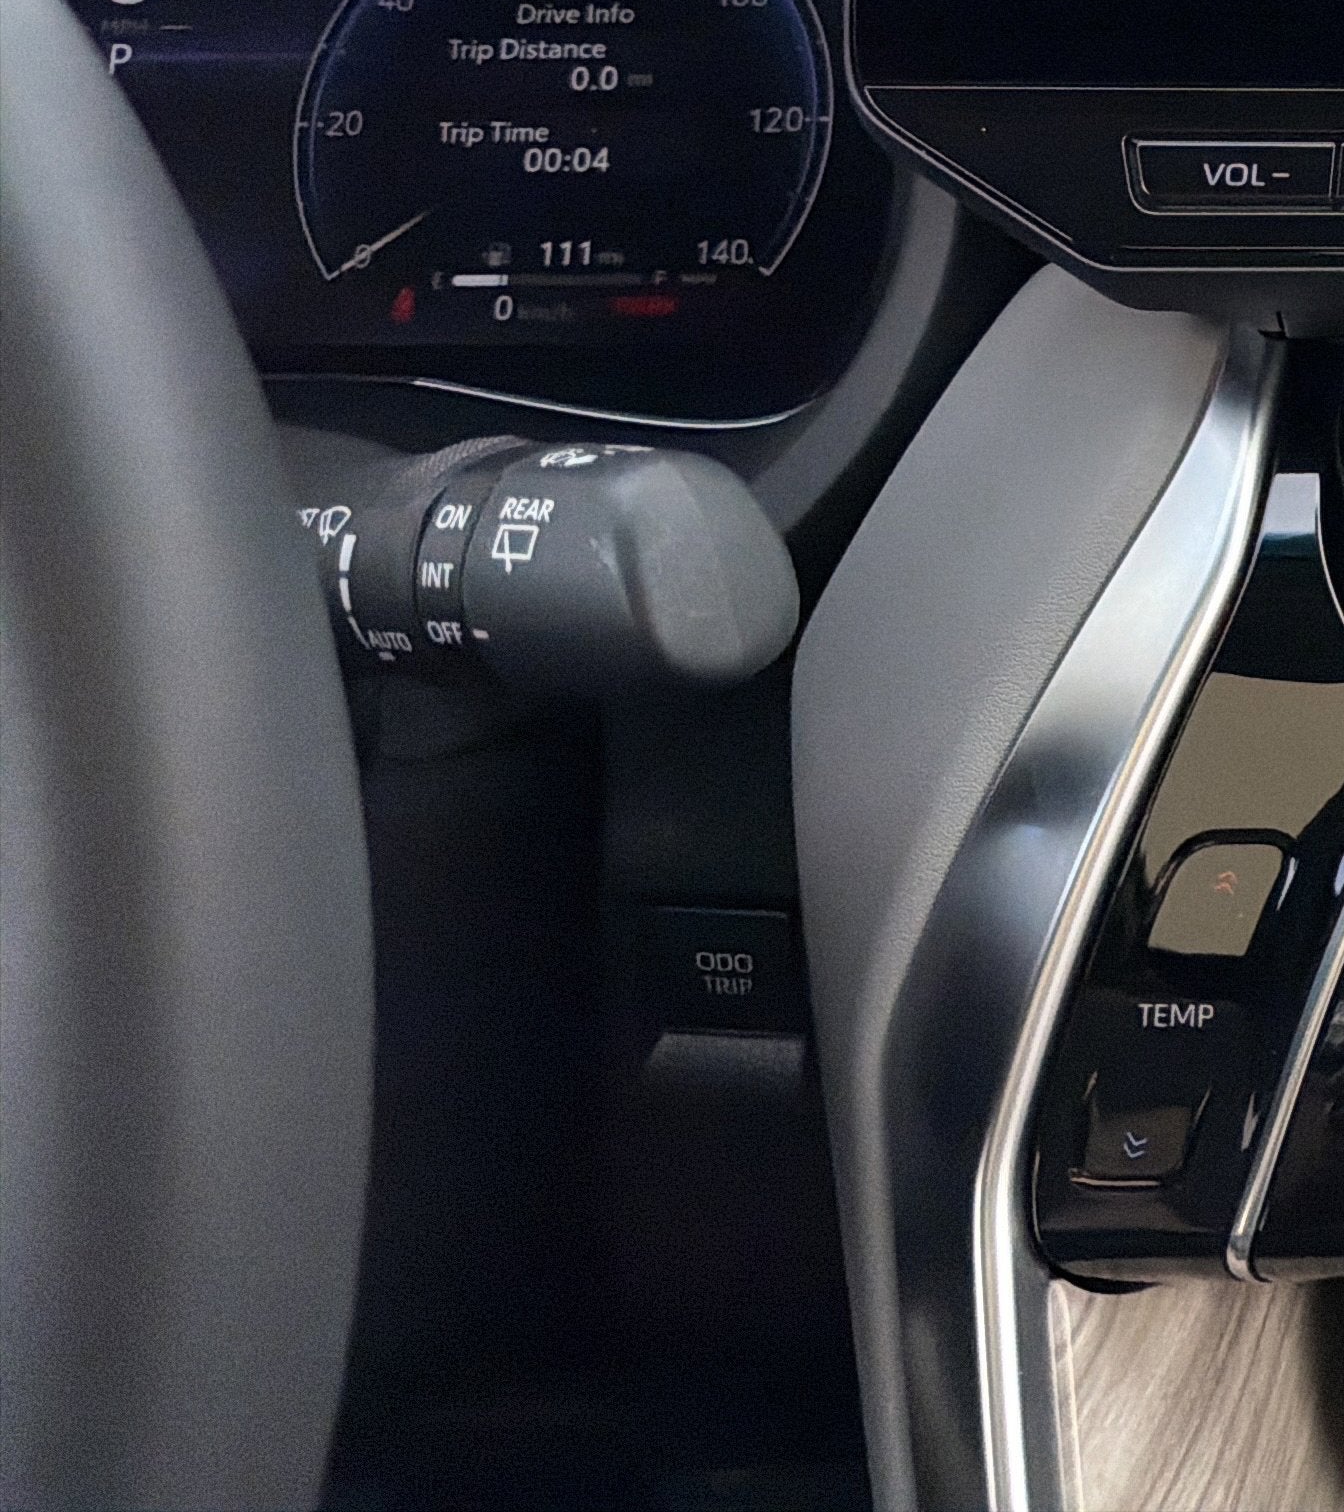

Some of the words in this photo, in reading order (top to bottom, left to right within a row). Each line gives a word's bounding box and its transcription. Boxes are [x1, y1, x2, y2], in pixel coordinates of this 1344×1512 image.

[517, 3, 581, 25] Drive
[586, 2, 636, 25] Info
[109, 43, 133, 75] P
[448, 38, 495, 65] Trip
[500, 38, 607, 60] Distance
[569, 66, 619, 91] 0.0
[325, 110, 364, 137] 20
[750, 106, 804, 134] 120
[439, 121, 485, 147] Trip
[490, 121, 550, 144] Time
[523, 147, 610, 173] 00:04
[540, 241, 592, 267] 111
[697, 238, 749, 265] 140
[493, 295, 514, 321] 0
[435, 504, 472, 531] ON
[500, 497, 555, 523] REAR
[421, 562, 454, 589] INT
[366, 630, 412, 654] AUTO
[427, 620, 464, 645] OFF
[696, 952, 753, 974] ODO
[703, 975, 753, 995] TRIP
[1138, 1003, 1215, 1030] TEMP
